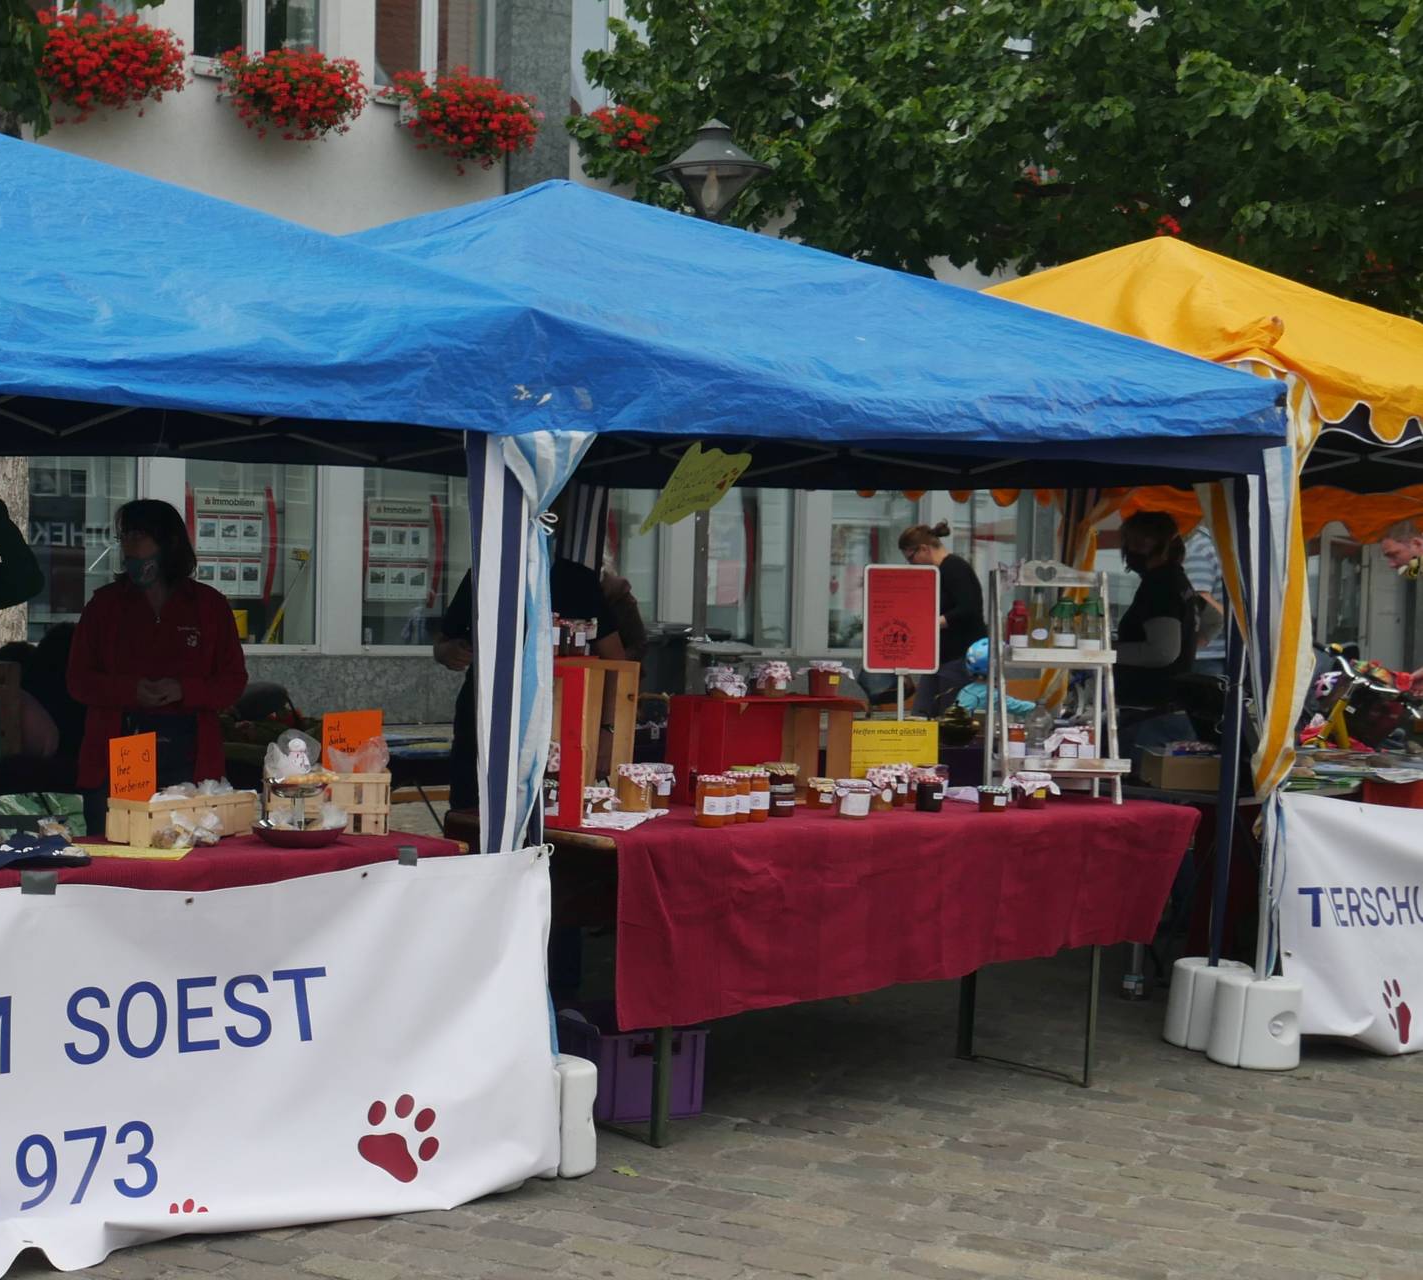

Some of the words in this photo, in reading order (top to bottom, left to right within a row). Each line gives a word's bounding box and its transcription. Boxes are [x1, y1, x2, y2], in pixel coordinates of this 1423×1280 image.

[211, 497, 256, 507] Immobilien
[853, 727, 876, 737] Helfen
[877, 727, 898, 735] macht
[899, 727, 928, 737] glücklich
[64, 966, 327, 1065] SOEST
